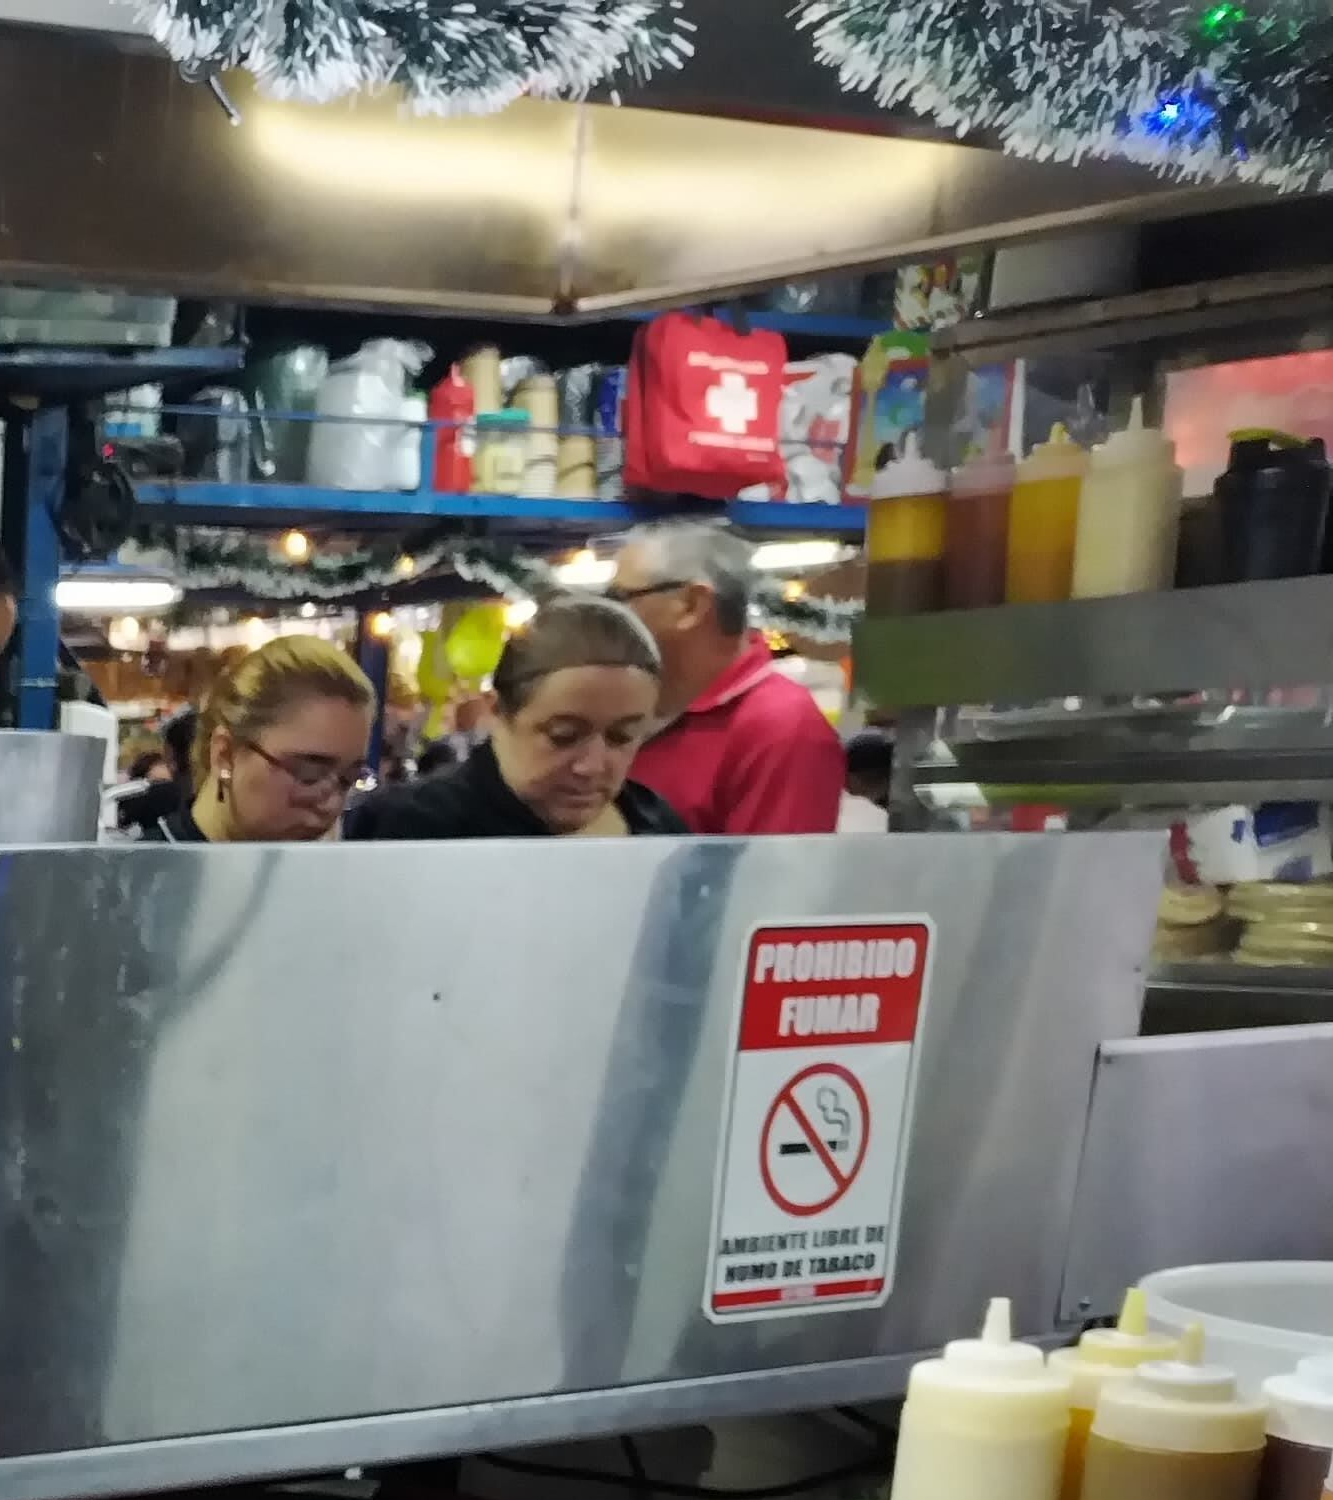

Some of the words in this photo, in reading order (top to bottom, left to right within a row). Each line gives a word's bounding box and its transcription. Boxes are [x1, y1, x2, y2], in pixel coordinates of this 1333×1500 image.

[753, 936, 917, 984] PROHIBIDO
[778, 992, 881, 1037] FUMAR
[719, 1231, 806, 1255] AMBIENTE
[813, 1226, 860, 1249] LIBRE
[866, 1224, 885, 1244] DE
[725, 1262, 778, 1284] HUMO
[782, 1259, 802, 1278] DE
[809, 1253, 876, 1276] TABACO
